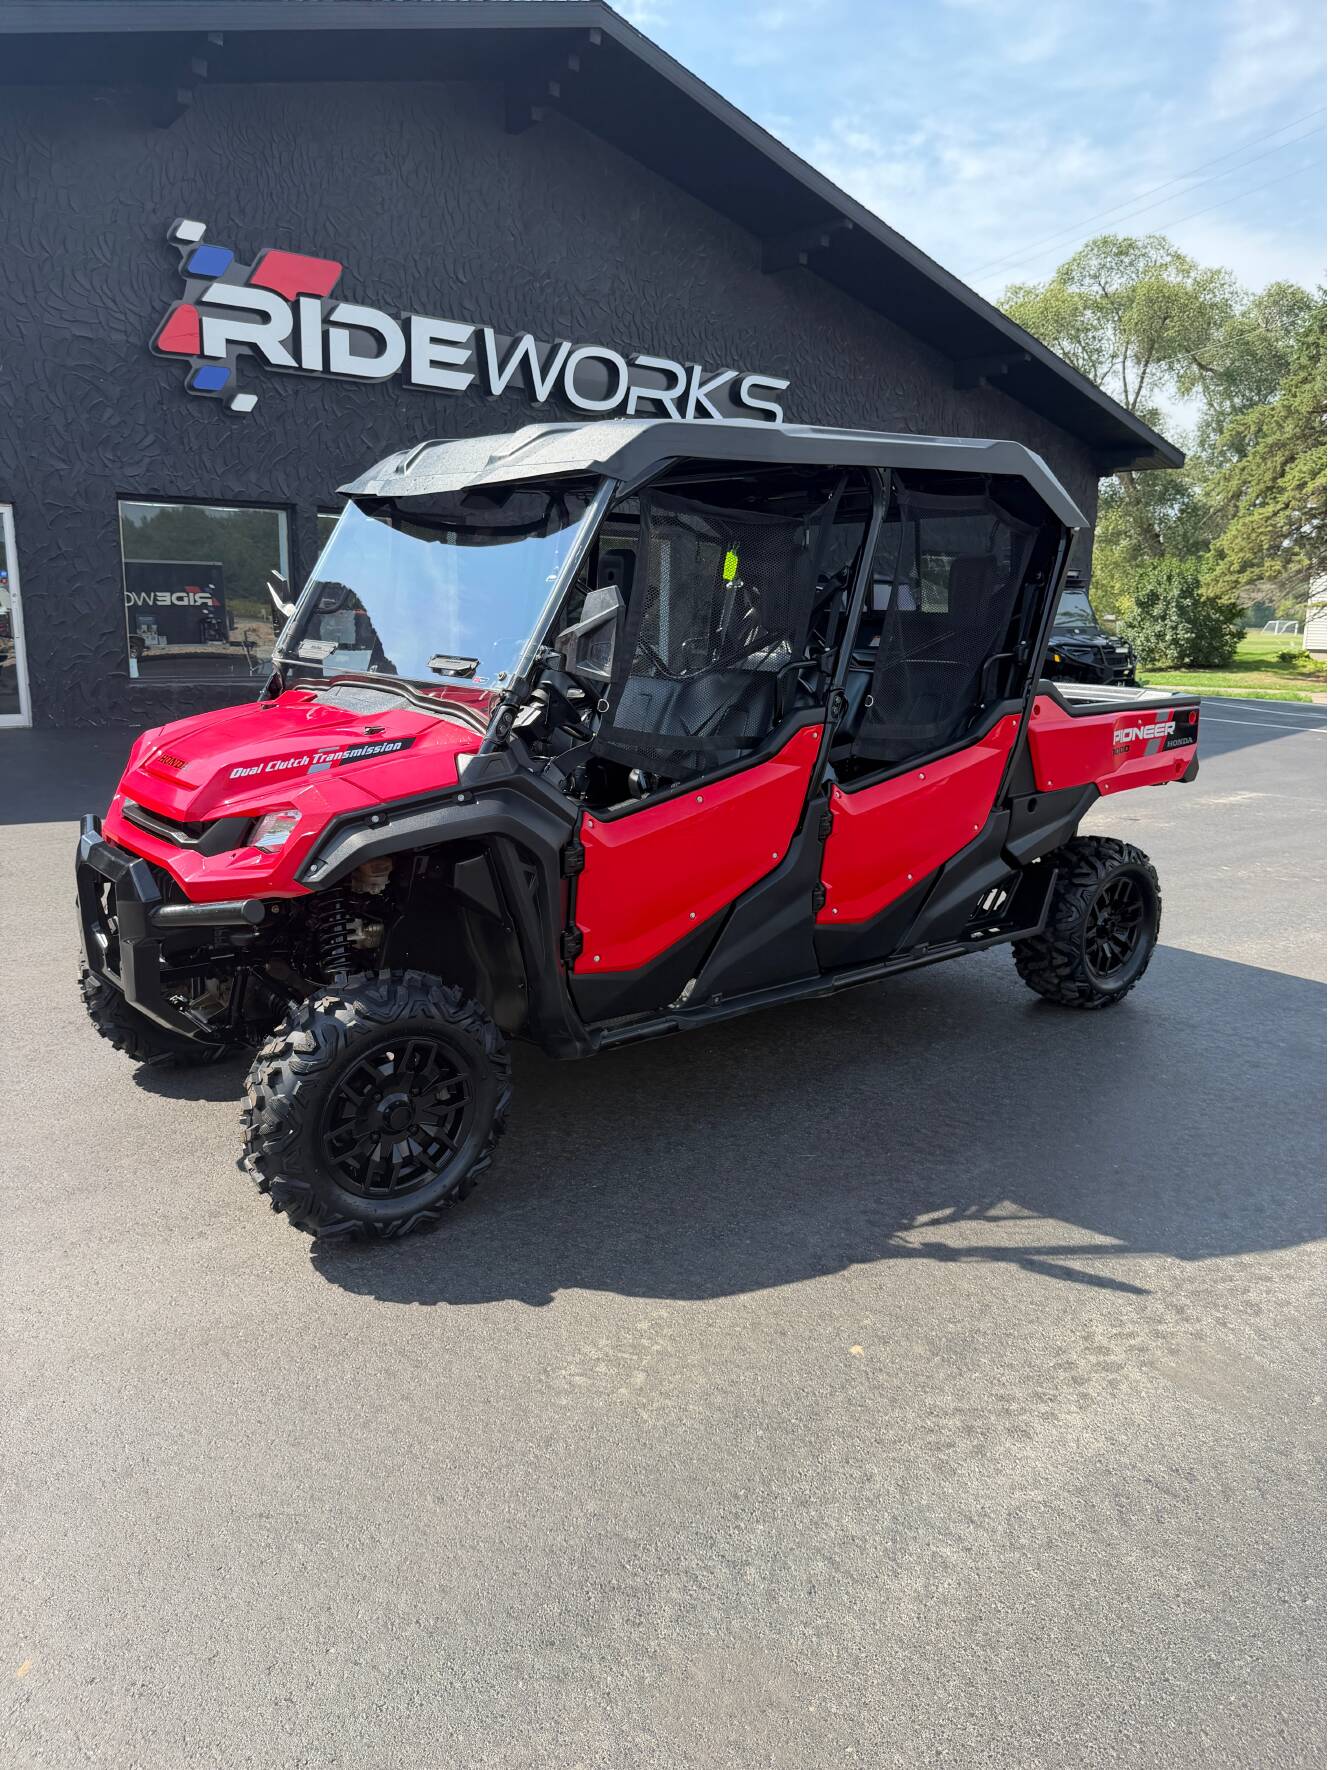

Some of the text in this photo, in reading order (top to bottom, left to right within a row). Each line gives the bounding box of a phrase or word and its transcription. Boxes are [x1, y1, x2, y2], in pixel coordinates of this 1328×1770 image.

[201, 282, 791, 424] RIDEWORKS
[1113, 721, 1175, 745] PIONEER
[1167, 737, 1193, 748] HONDA
[230, 741, 403, 779] Dual Clutch Transmission
